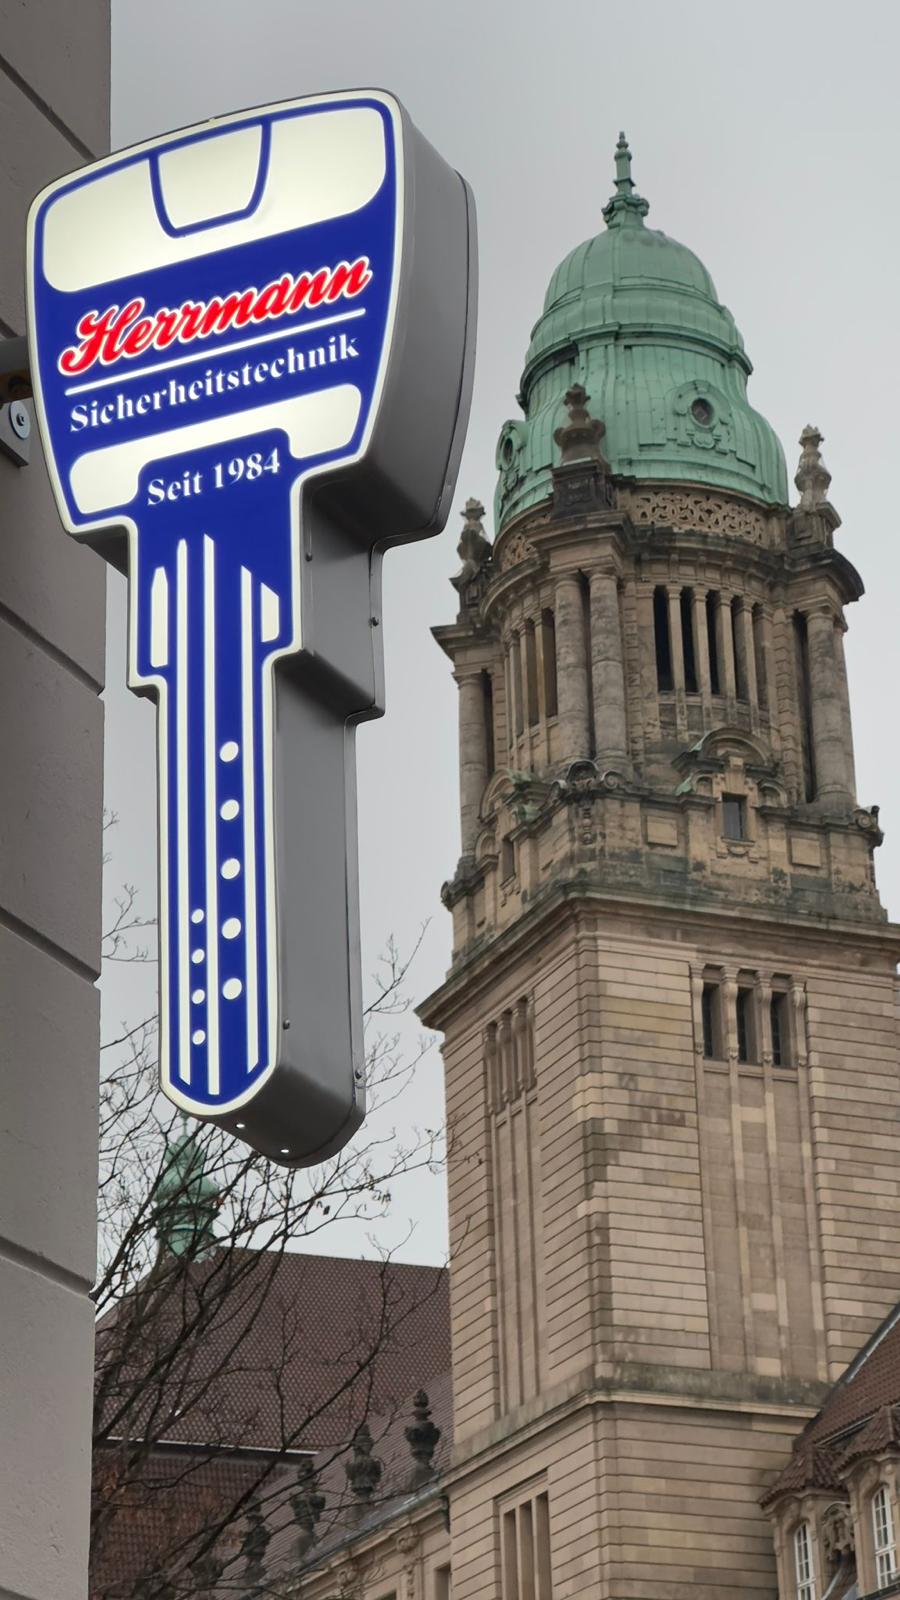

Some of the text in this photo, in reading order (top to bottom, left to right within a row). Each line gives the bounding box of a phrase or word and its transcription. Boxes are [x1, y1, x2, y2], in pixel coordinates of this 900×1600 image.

[58, 257, 372, 375] Herrmann
[70, 333, 360, 432] Sicherheitstechnik
[147, 447, 280, 506] Seit 1984
